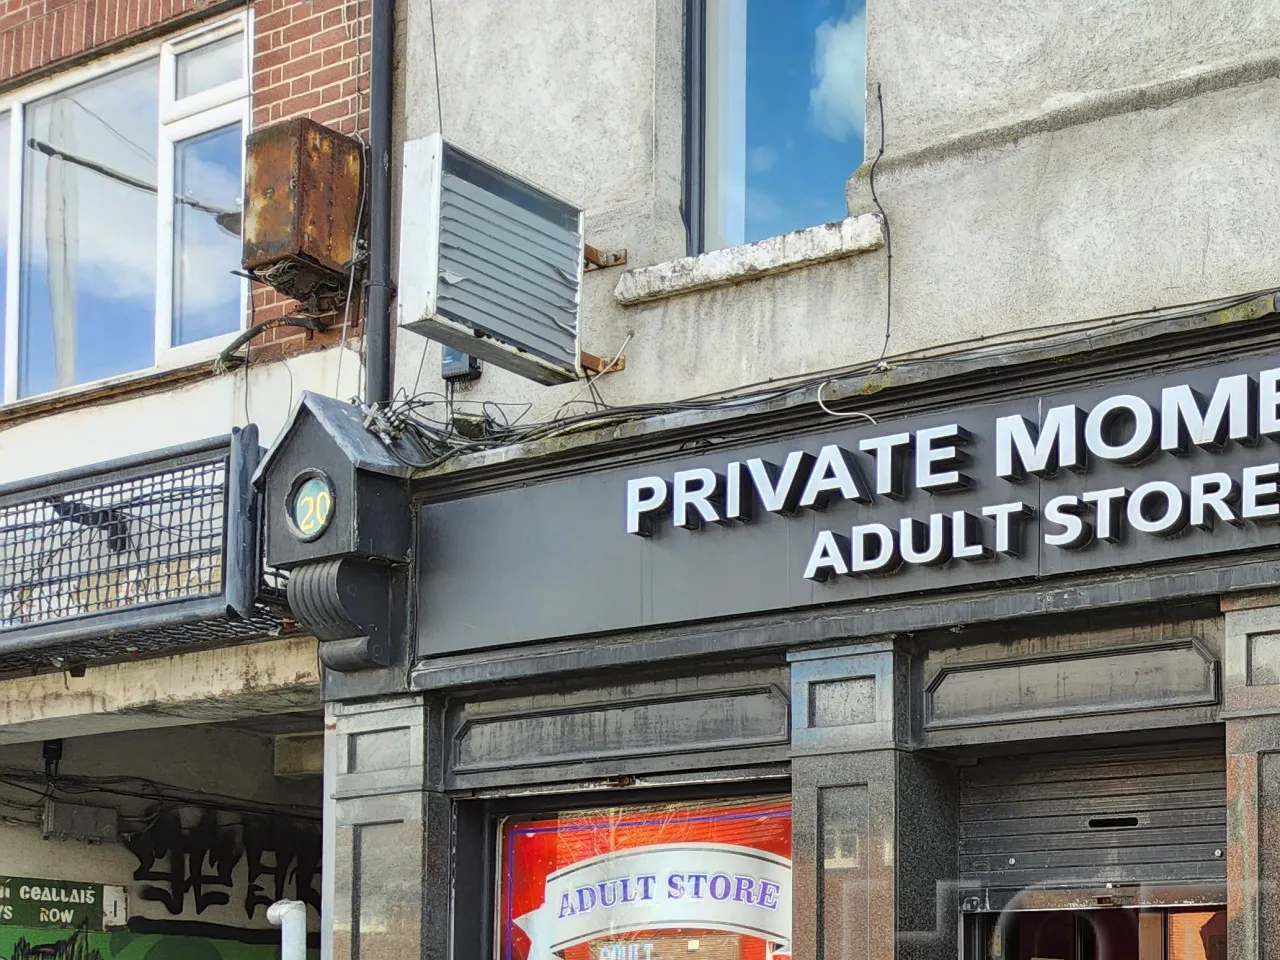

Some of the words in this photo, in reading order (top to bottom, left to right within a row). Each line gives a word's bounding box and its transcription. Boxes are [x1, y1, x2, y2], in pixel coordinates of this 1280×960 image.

[625, 423, 966, 536] PRIVATE
[300, 491, 331, 530] 20
[803, 501, 1027, 581] ADULT
[40, 908, 74, 923] ROW
[558, 874, 657, 919] ADULT
[667, 873, 782, 911] STORE
